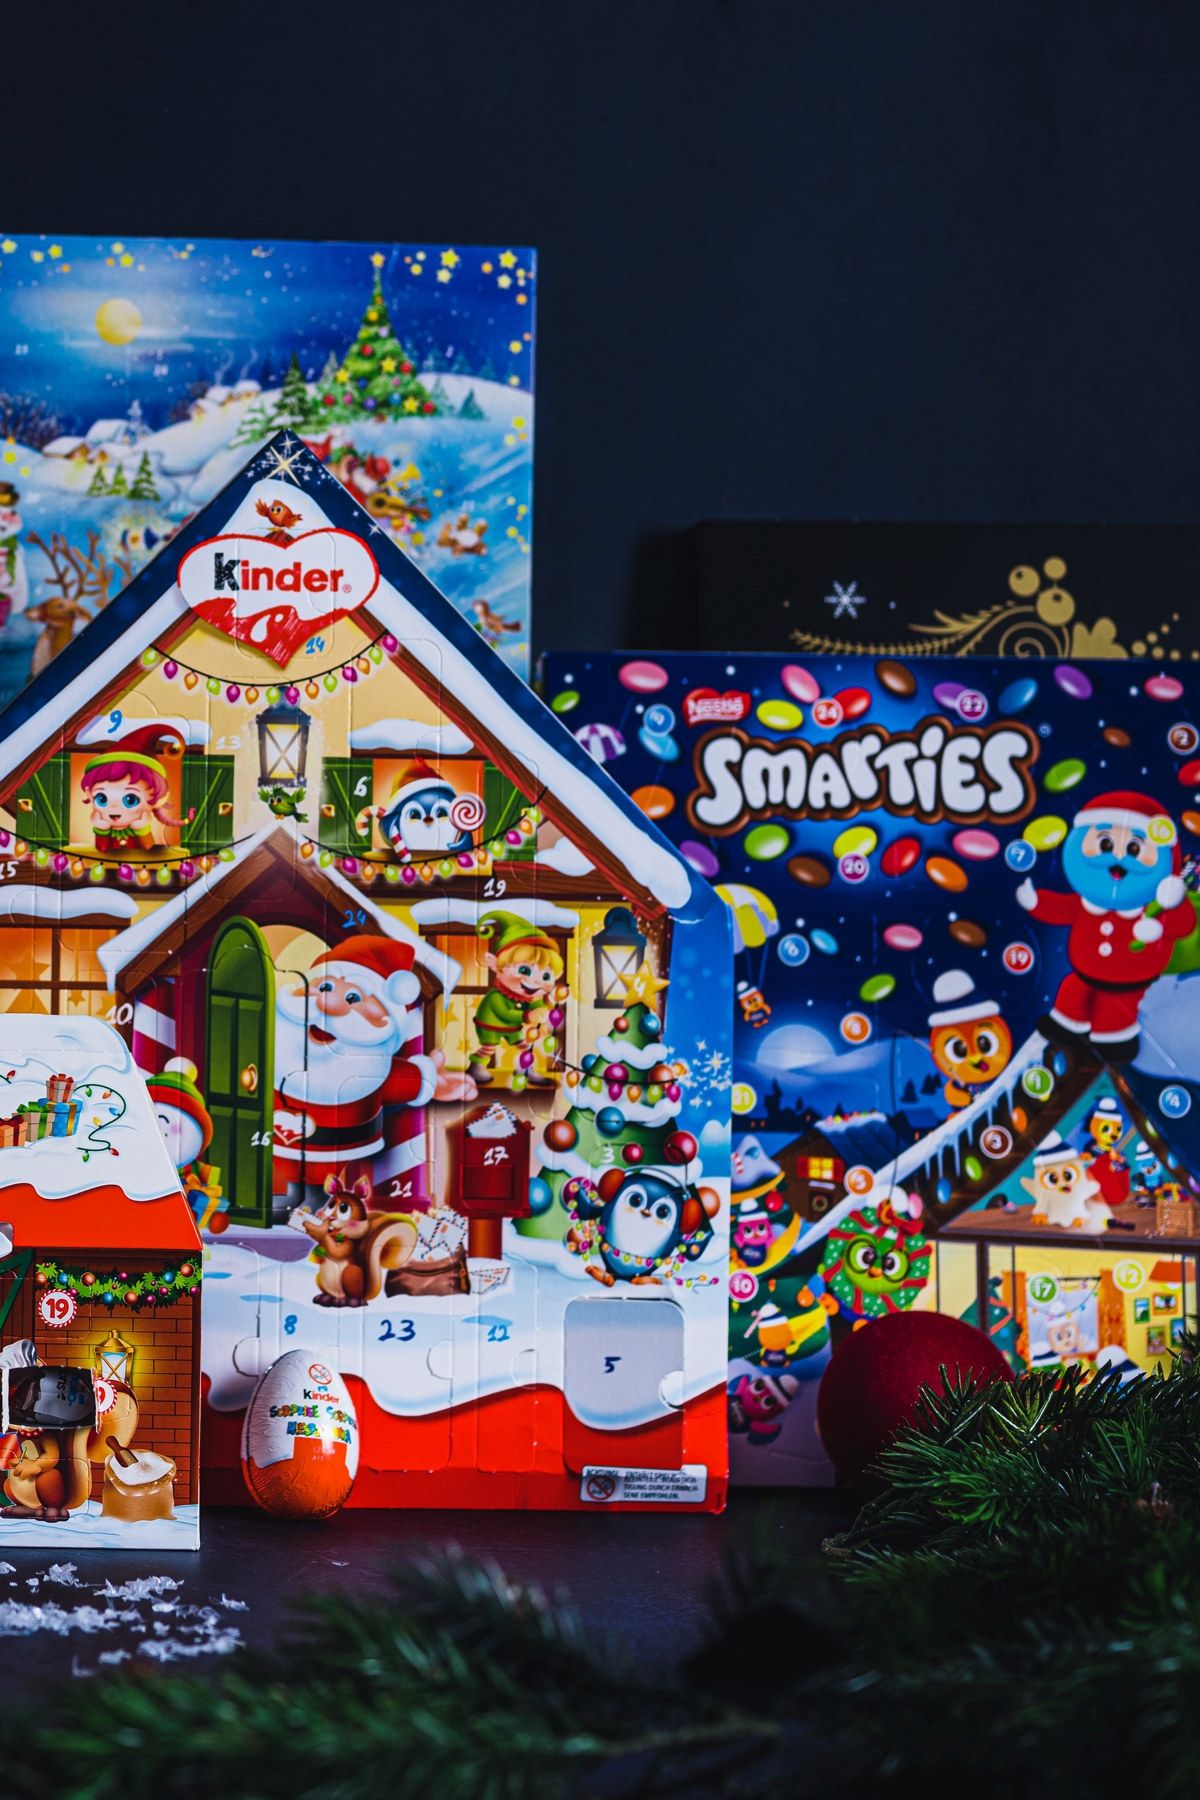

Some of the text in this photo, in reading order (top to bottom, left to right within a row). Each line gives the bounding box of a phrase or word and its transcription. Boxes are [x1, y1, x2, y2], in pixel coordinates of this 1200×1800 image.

[107, 710, 123, 733] 9
[215, 736, 242, 751] 13
[354, 775, 369, 797] 6
[844, 858, 865, 875] 20
[483, 879, 506, 897] 19
[342, 910, 367, 929] 24
[1009, 949, 1029, 967] 19
[634, 976, 647, 998] 4
[103, 1002, 134, 1026] 10
[250, 1131, 271, 1148] 16
[483, 1146, 509, 1166] 17
[602, 1145, 616, 1164] 3
[389, 1181, 414, 1198] 21
[1119, 1267, 1140, 1284] 12
[732, 1276, 753, 1295] 10
[1034, 1280, 1054, 1299] 17
[46, 1298, 70, 1319] 19
[284, 1314, 298, 1335] 8
[377, 1319, 416, 1342] 23
[487, 1324, 513, 1342] 12
[603, 1356, 622, 1374] 5
